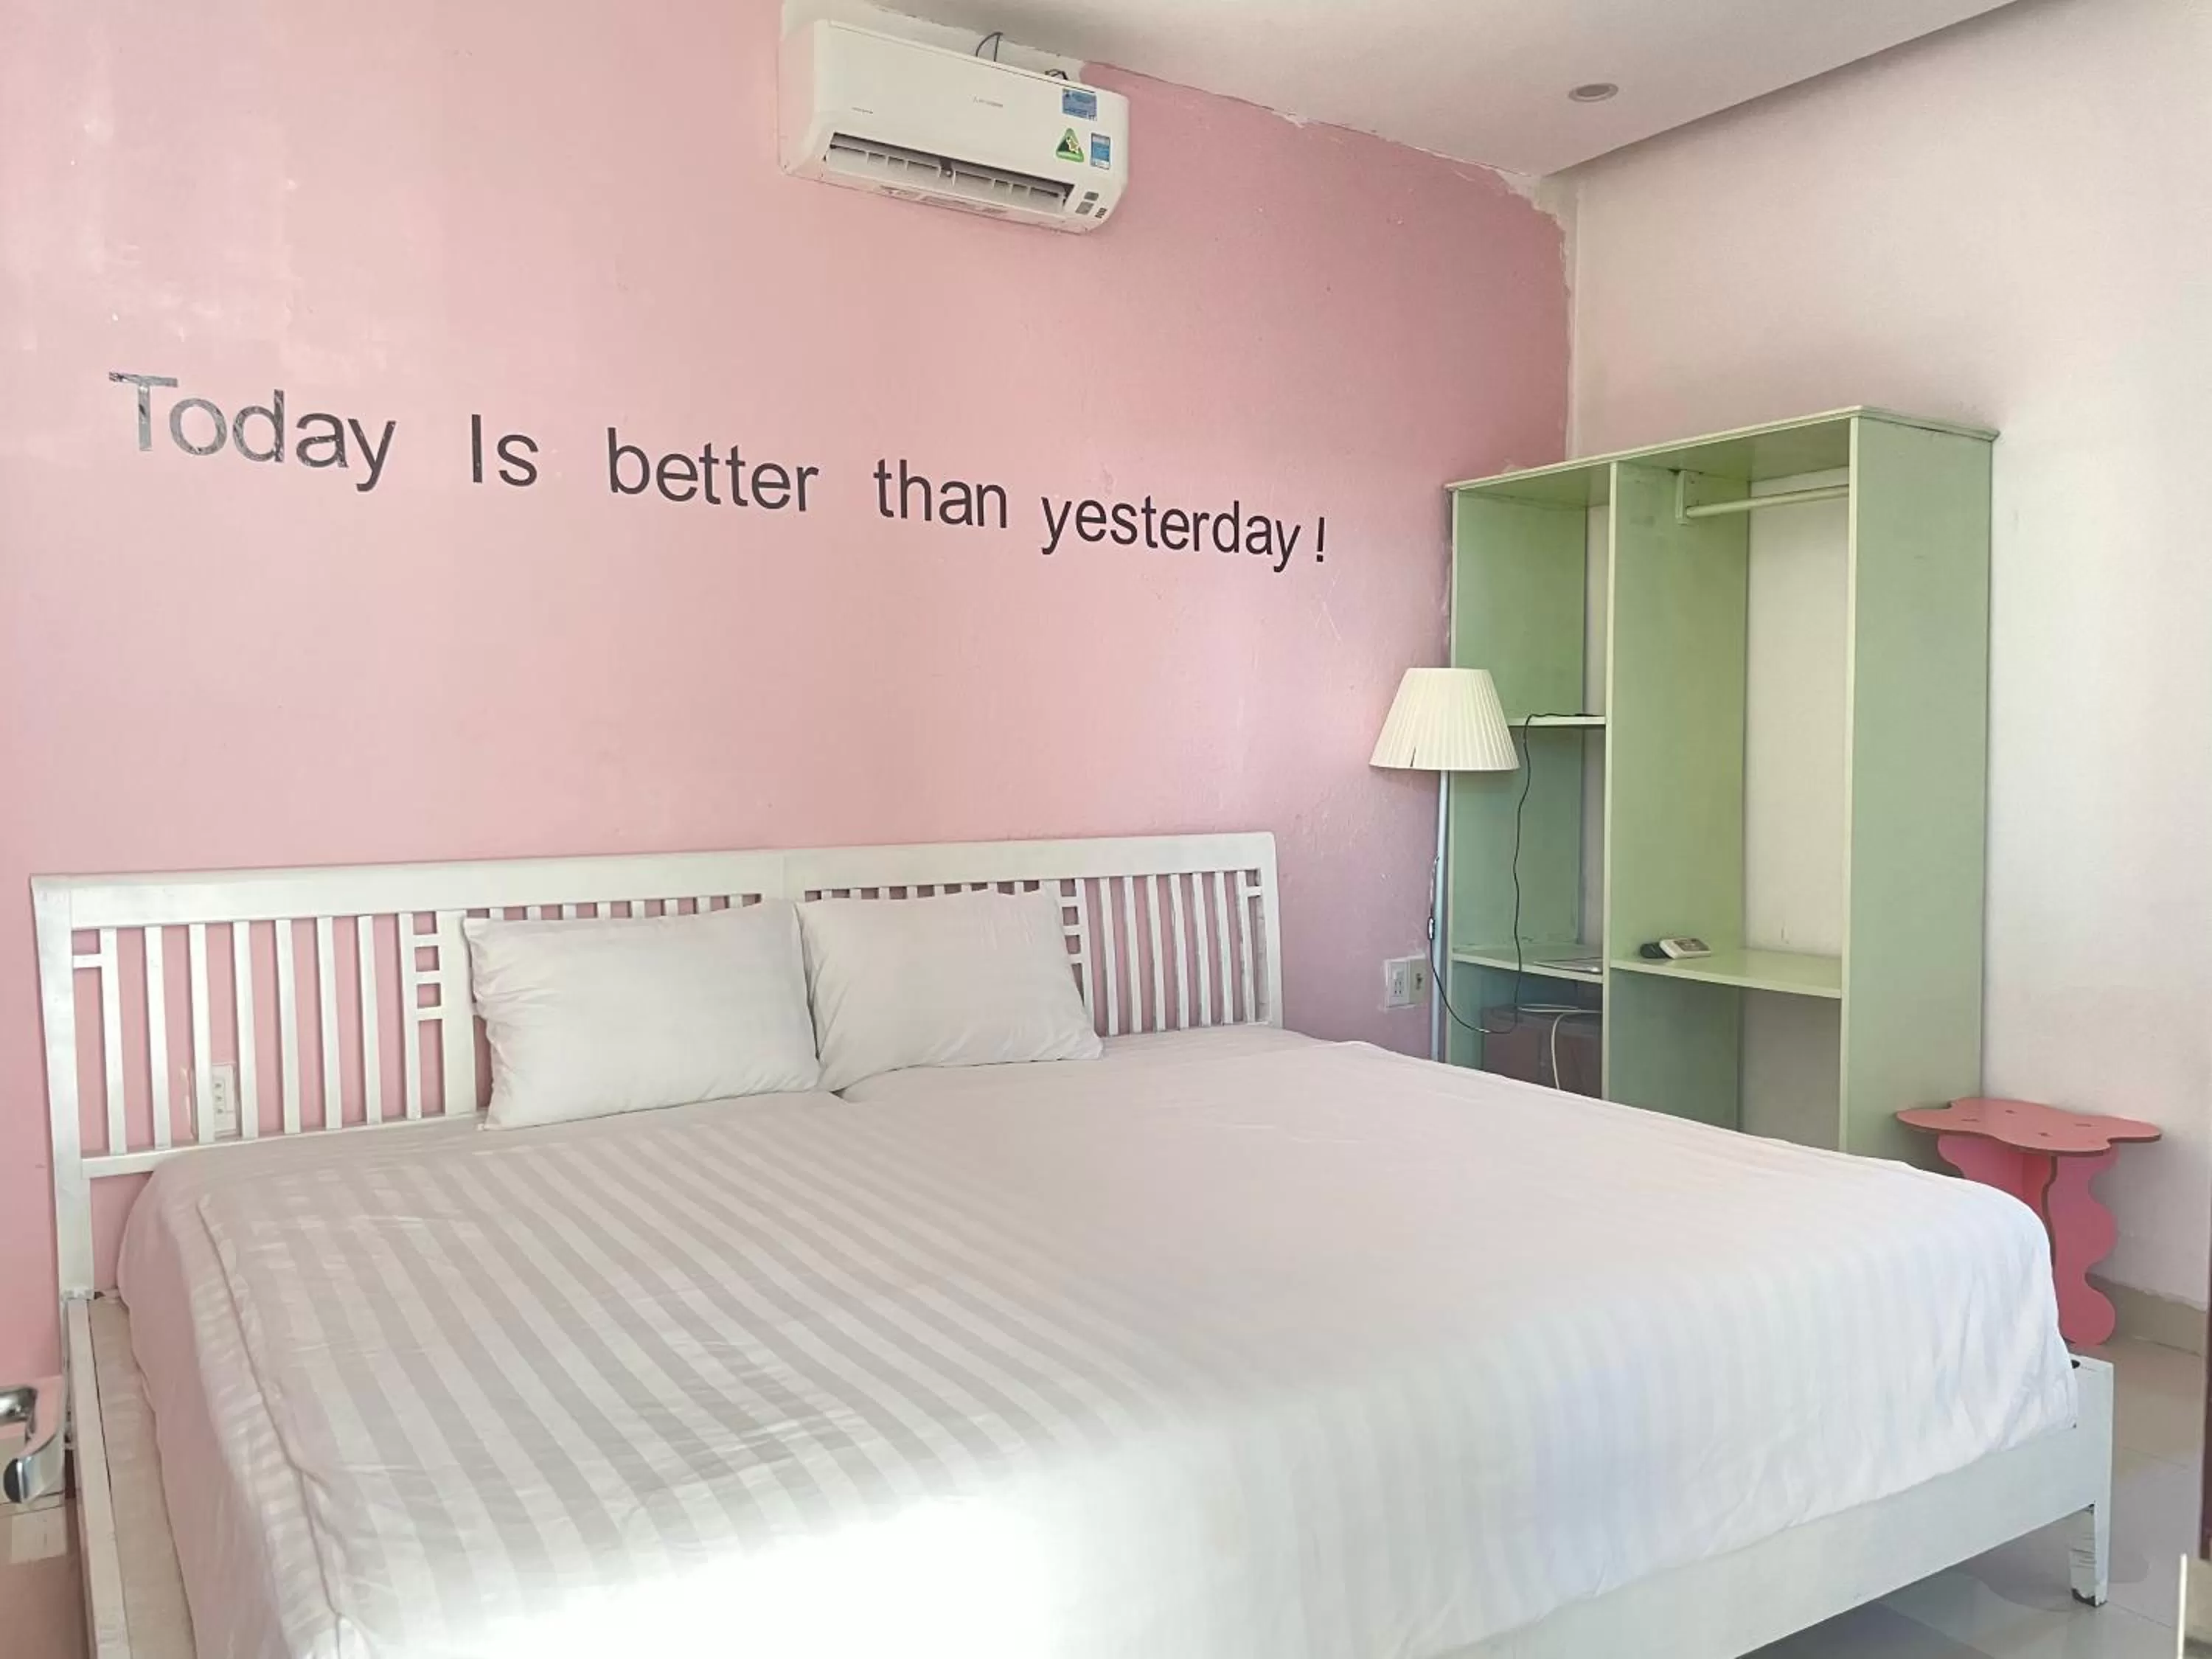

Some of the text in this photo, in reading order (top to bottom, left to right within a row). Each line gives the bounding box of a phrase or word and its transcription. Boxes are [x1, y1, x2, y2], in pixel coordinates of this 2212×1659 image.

[108, 371, 397, 493] Today
[471, 414, 539, 487] Is
[607, 426, 820, 512] better
[872, 458, 1007, 529] than
